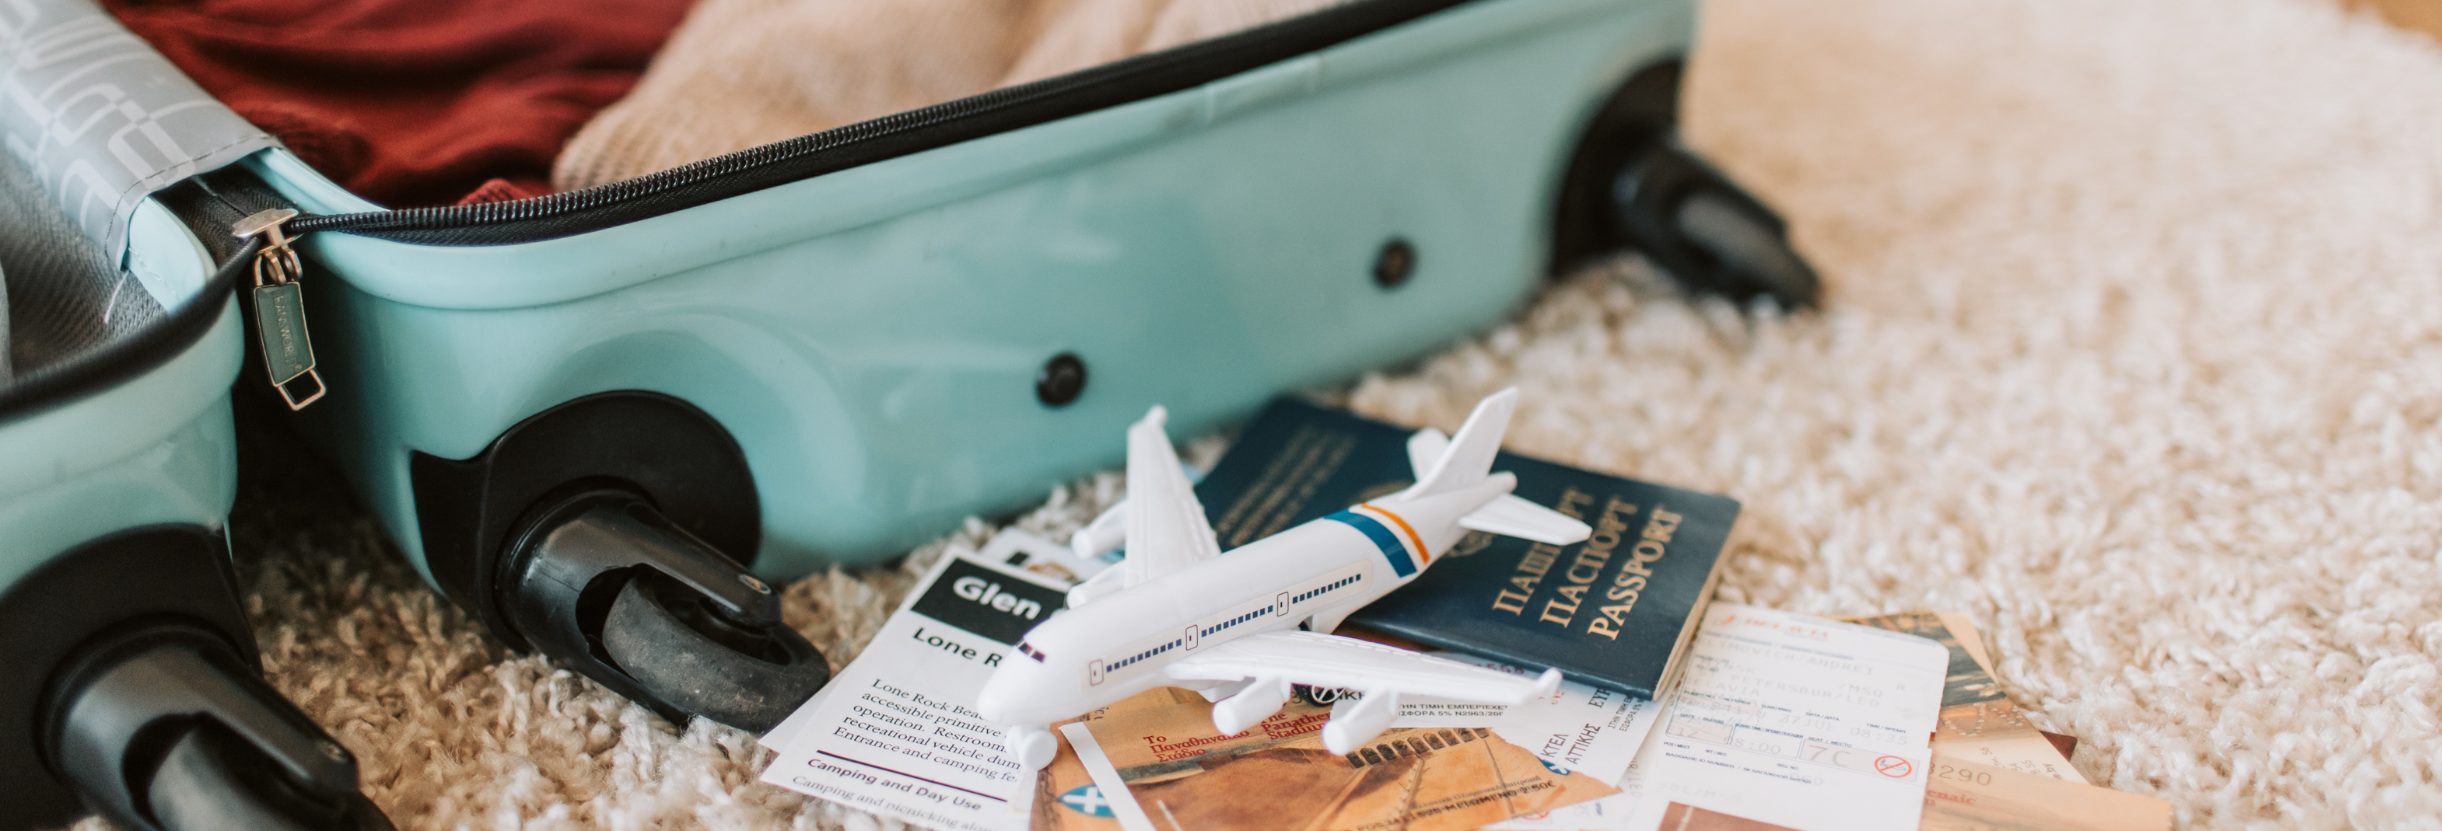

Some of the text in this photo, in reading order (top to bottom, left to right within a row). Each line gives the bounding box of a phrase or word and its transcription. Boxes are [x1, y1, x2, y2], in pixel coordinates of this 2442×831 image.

[1493, 486, 1595, 616] ПАШРТ
[1540, 496, 1638, 629] ПАСПОРТ
[1587, 506, 1683, 641] PASSPORT
[952, 575, 1042, 620] Glen
[912, 626, 978, 661] Lone
[861, 692, 1002, 738] accessible primitive
[872, 678, 910, 699] Lone
[912, 693, 950, 712] Rock
[852, 703, 926, 733] operation.
[832, 725, 900, 753] Entrance
[902, 746, 933, 761] and
[933, 755, 999, 781] camping
[842, 716, 1022, 773] recreational vehicle dum
[1540, 733, 1569, 758] ΚΤΕΛ
[1564, 723, 1602, 765] ΑΤΤΙΚΗΣ
[792, 774, 858, 802] Camping
[858, 794, 885, 807] and
[807, 757, 983, 811] Camping and Day Use
